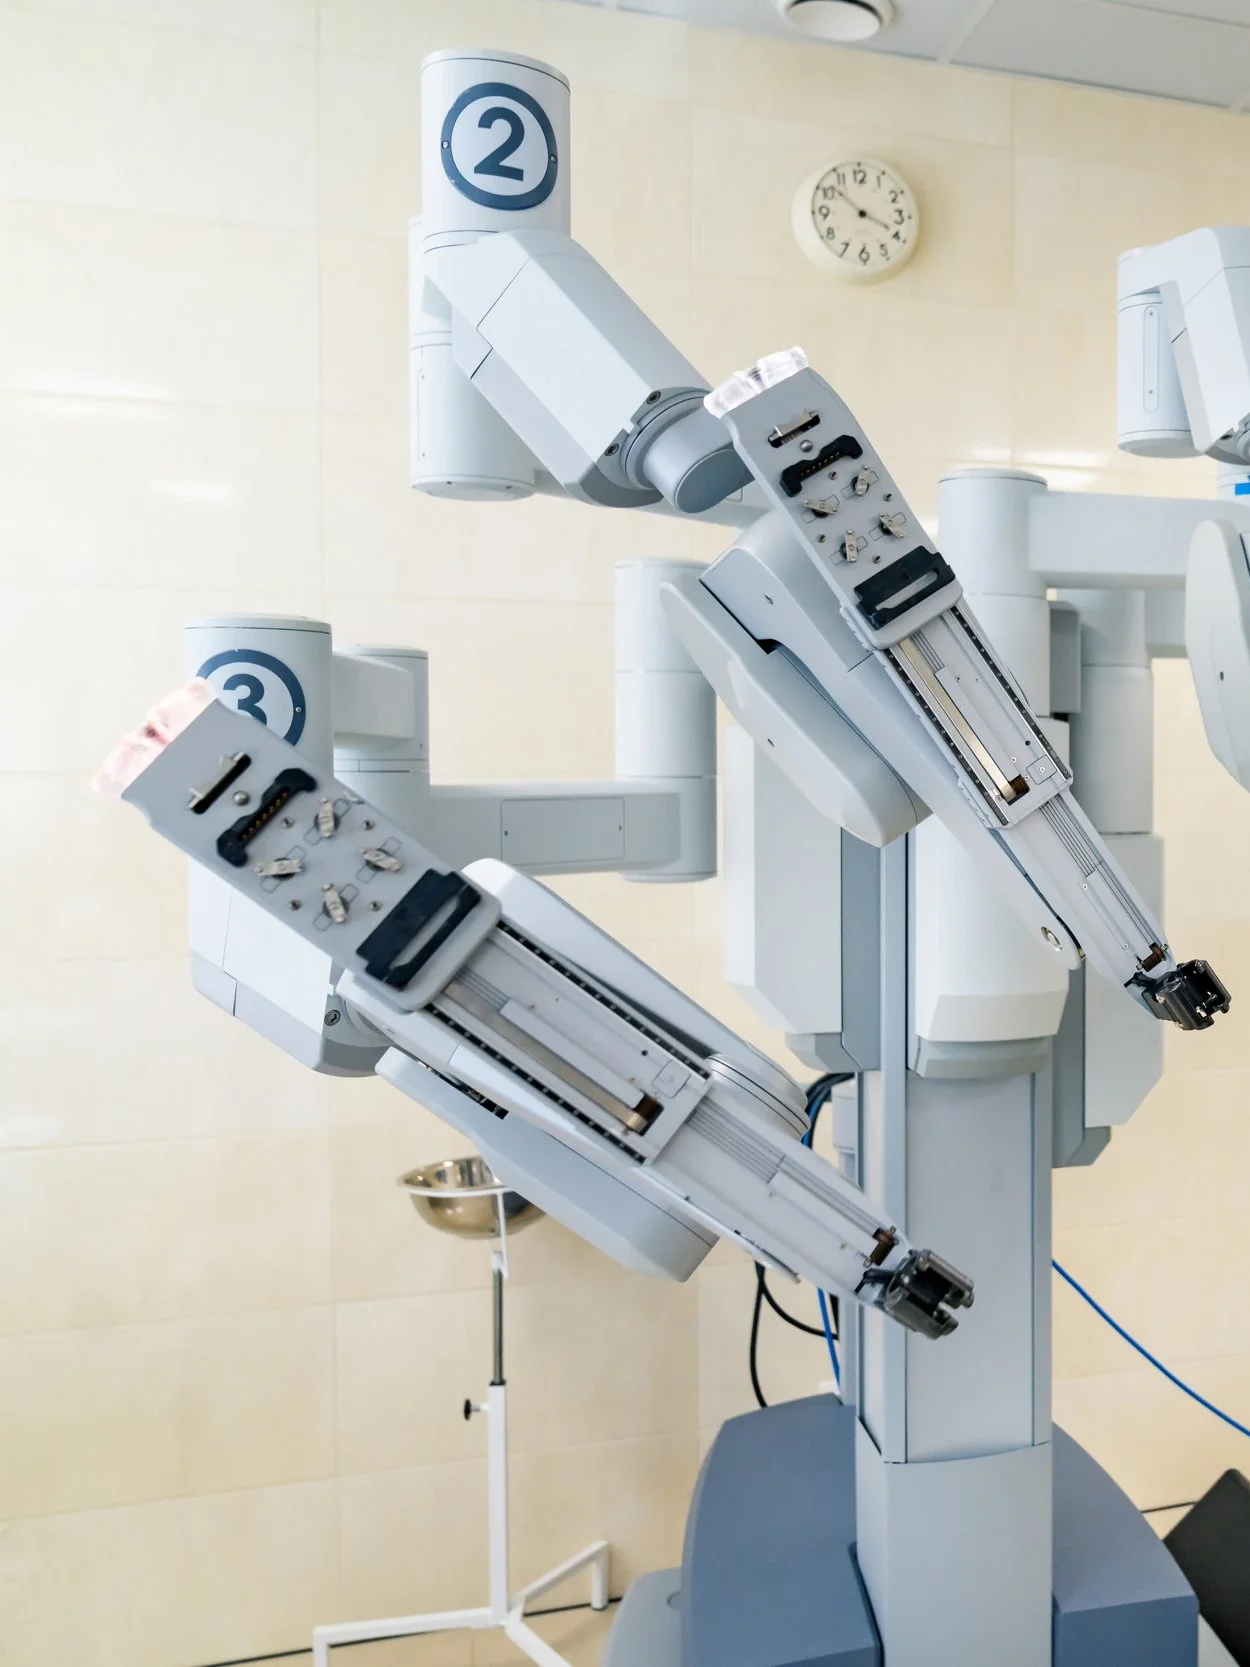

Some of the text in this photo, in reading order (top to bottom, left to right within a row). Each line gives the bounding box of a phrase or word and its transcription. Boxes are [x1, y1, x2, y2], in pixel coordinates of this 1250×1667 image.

[474, 107, 525, 182] 2
[836, 173, 846, 186] 11
[852, 169, 867, 184] 12
[876, 175, 882, 188] 1
[822, 185, 836, 200] 10
[889, 190, 899, 204] 2
[818, 205, 830, 221] 9
[893, 209, 904, 225] 3
[826, 227, 835, 240] 8
[892, 231, 901, 240] 4
[840, 242, 850, 258] 7
[858, 246, 870, 262] 6
[879, 244, 888, 257] 5
[222, 673, 267, 727] 3
